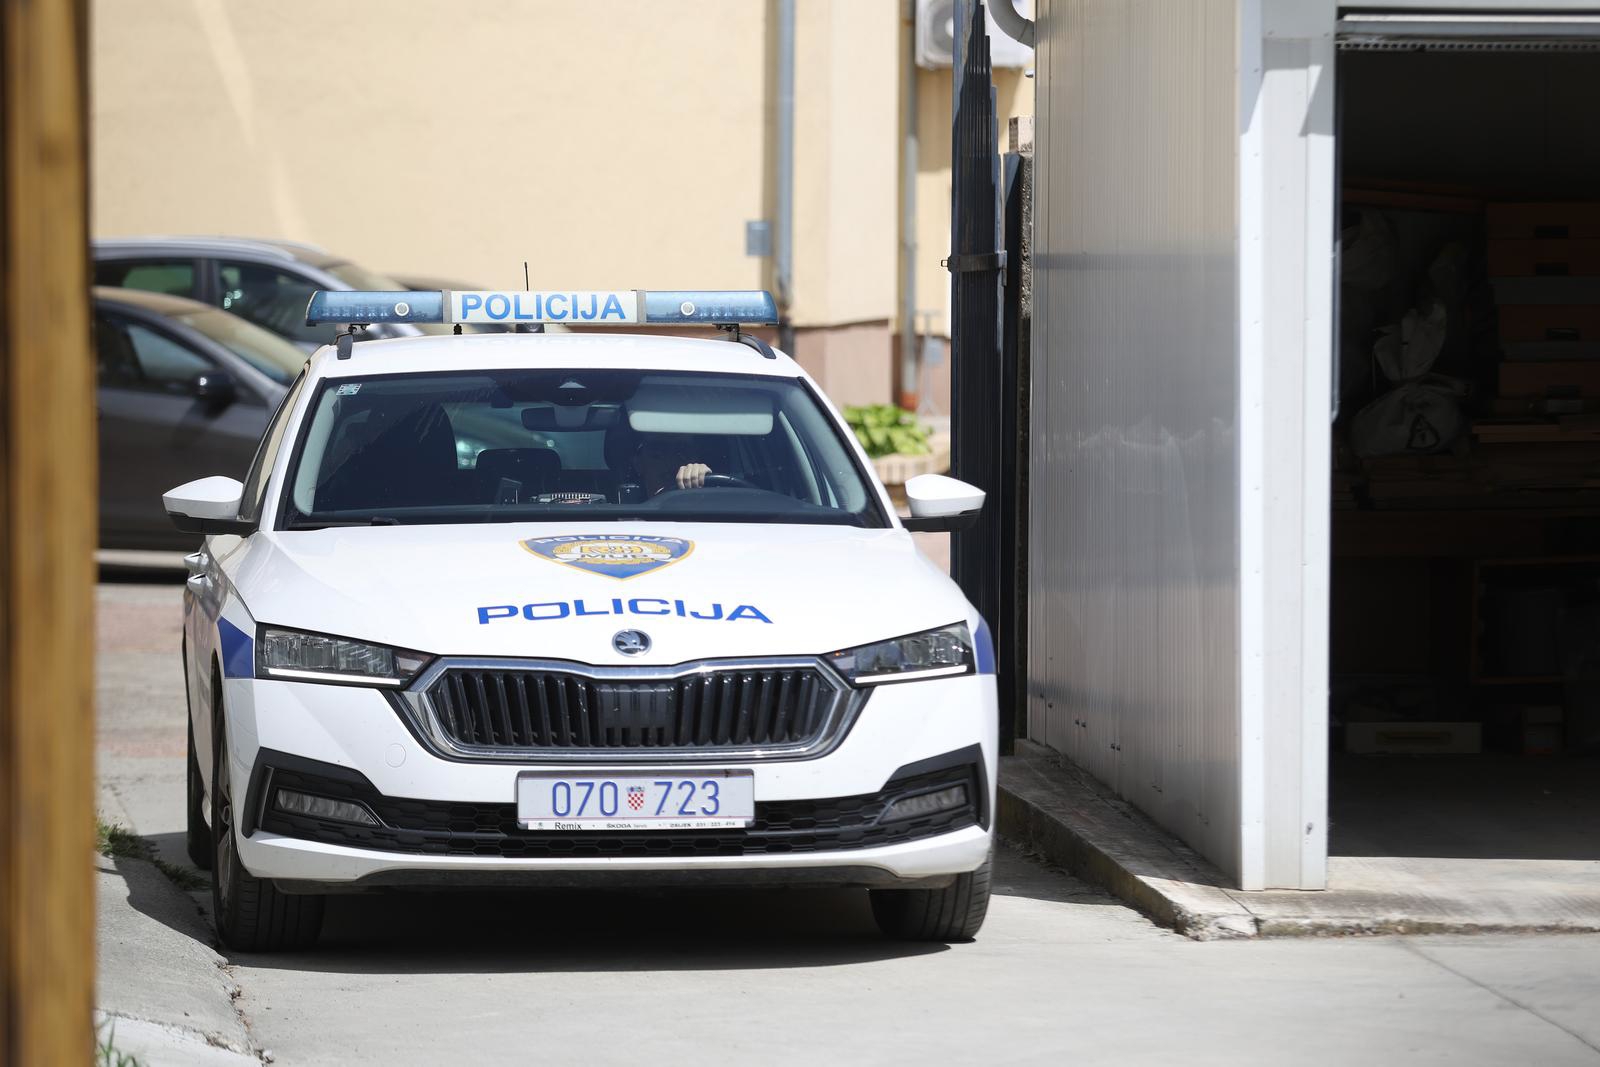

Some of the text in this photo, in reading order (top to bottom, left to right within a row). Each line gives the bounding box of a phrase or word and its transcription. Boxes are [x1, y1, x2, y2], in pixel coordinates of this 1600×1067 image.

[461, 293, 625, 320] POLICIJA
[533, 535, 683, 544] POLICIJA
[477, 598, 774, 624] POLICIJA
[552, 780, 719, 817] 070 723
[554, 822, 582, 830] Remix
